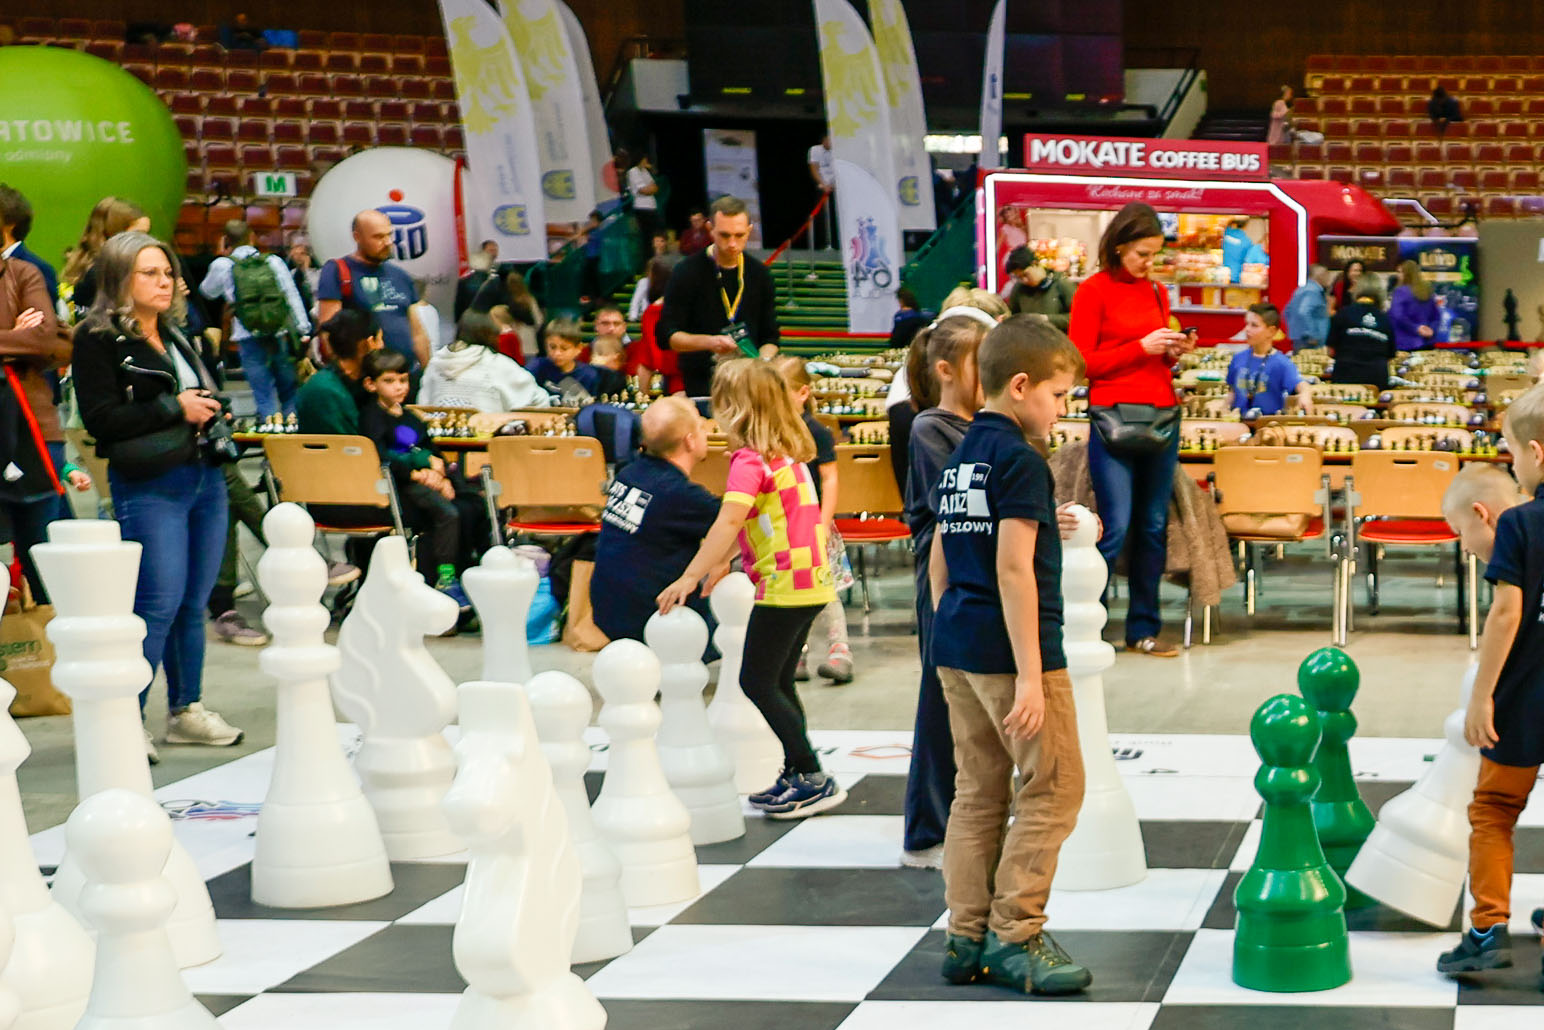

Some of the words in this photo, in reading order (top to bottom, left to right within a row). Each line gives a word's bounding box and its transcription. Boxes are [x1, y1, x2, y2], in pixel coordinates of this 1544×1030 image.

[1030, 138, 1146, 168] MOKATE
[1149, 150, 1220, 169] COFFEE
[1220, 153, 1260, 171] BUS
[265, 176, 286, 193] M
